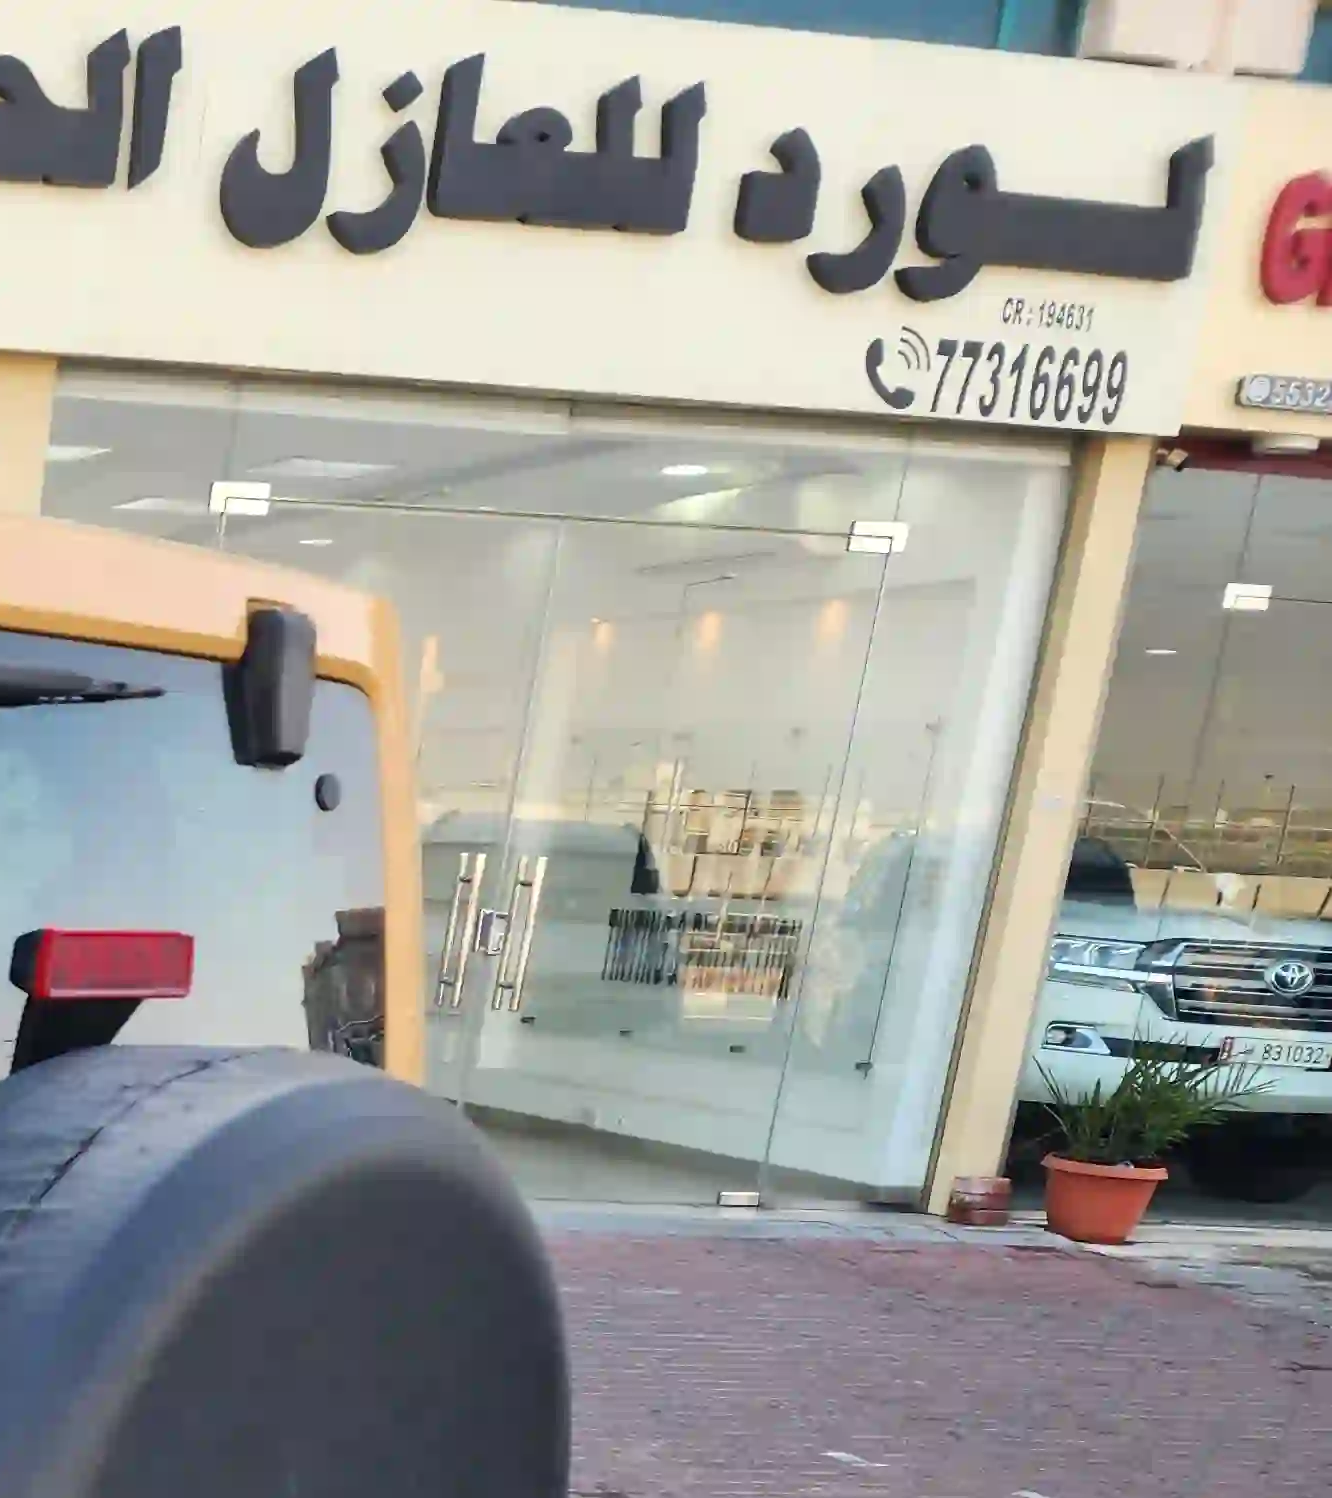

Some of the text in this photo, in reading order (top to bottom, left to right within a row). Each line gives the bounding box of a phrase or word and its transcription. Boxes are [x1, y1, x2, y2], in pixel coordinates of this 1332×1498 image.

[218, 46, 708, 254] للعازل
[734, 126, 1215, 303] لورد
[1037, 302, 1094, 332] 194631
[930, 338, 1128, 426] 77316699
[1262, 1043, 1324, 1064] 831032
